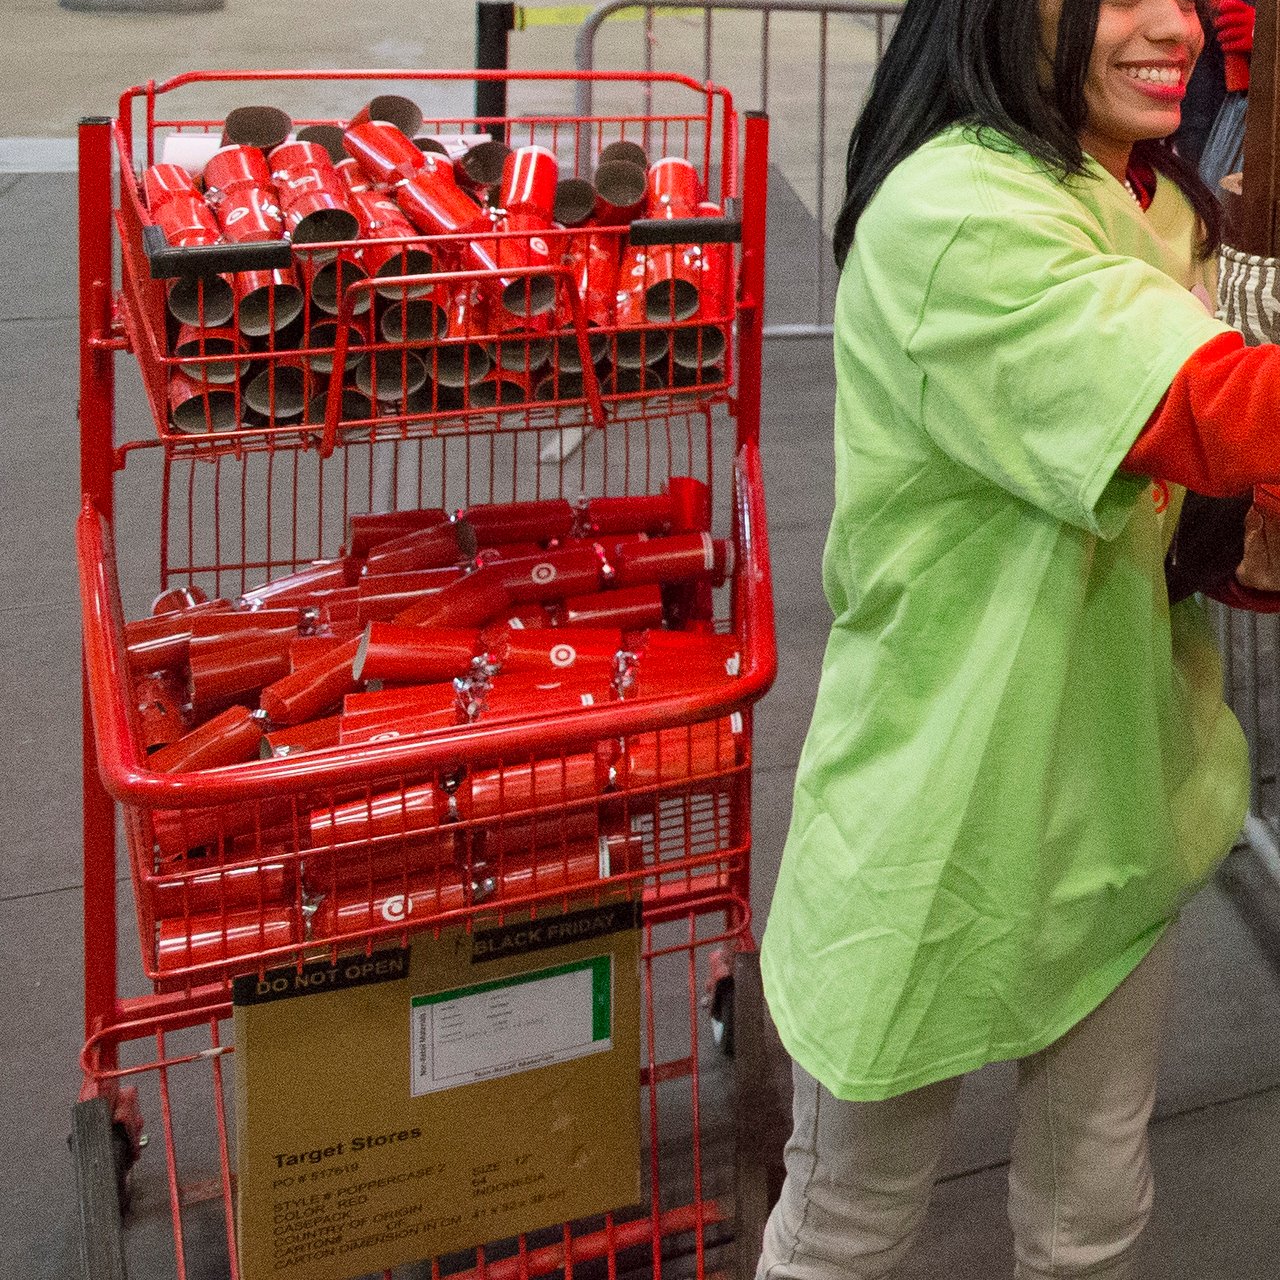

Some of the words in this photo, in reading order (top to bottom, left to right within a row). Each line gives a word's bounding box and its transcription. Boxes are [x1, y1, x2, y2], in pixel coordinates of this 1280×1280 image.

[473, 927, 541, 956] BLACK
[545, 912, 614, 941] FRIDAY
[256, 978, 288, 997] DO
[298, 968, 341, 989] NOT
[345, 956, 405, 980] OPEN
[275, 1143, 345, 1168] Target
[351, 1127, 422, 1152] Stores
[273, 1177, 294, 1189] PO
[273, 1194, 320, 1212] STYLE
[337, 1167, 437, 1197] POPPERCASE
[273, 1205, 325, 1224] COLOR
[337, 1194, 368, 1209] RED
[273, 1211, 351, 1236] CASEPACK
[273, 1225, 345, 1248] COUNTRY
[349, 1219, 368, 1229] OF
[373, 1204, 424, 1223] ORIGIN
[273, 1248, 335, 1270] CARTON
